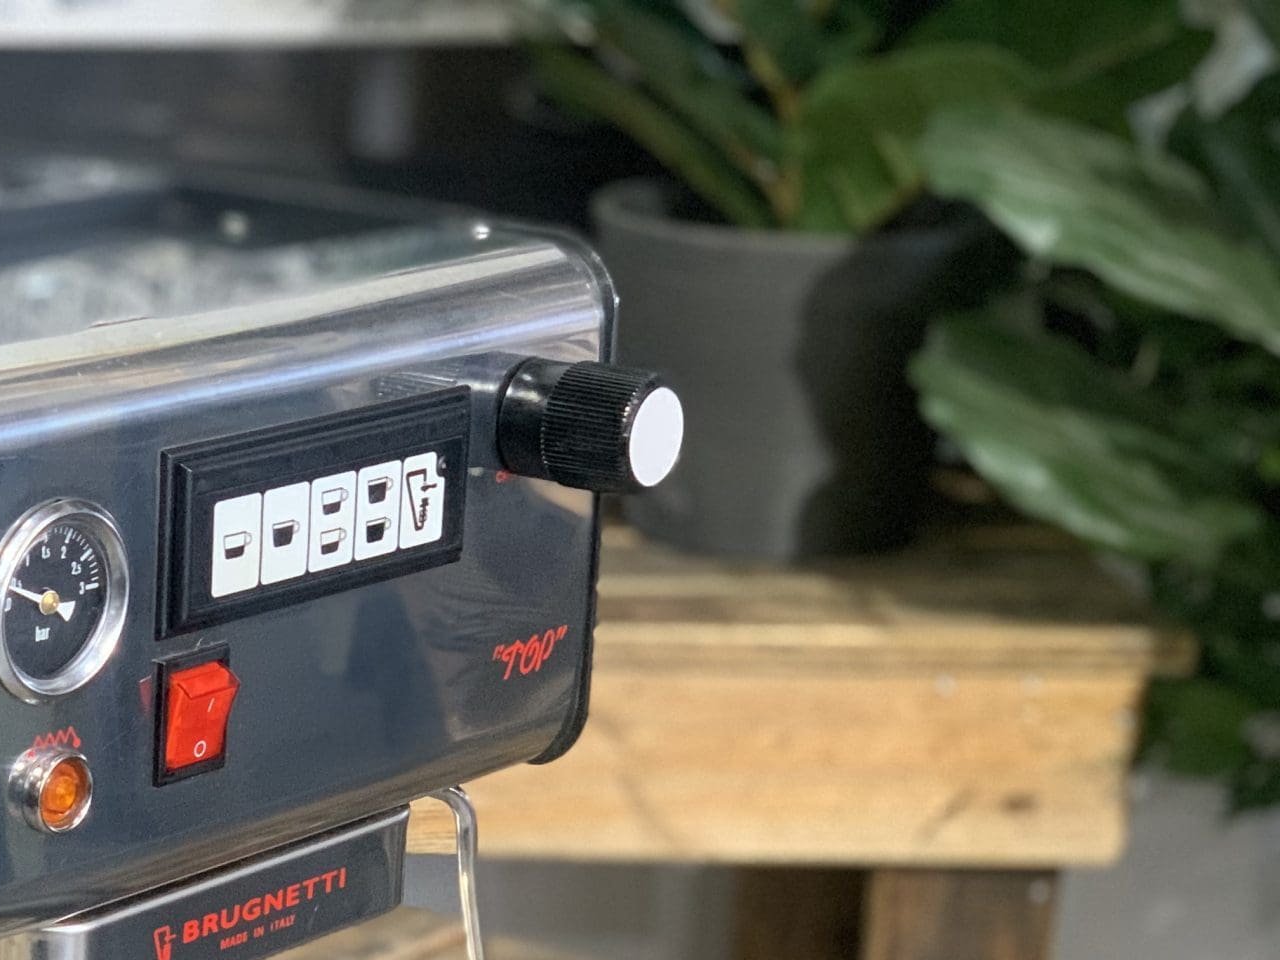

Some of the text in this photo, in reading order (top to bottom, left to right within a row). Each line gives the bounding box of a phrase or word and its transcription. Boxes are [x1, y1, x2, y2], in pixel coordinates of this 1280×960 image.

[60, 545, 67, 560] 2
[78, 581, 85, 595] 3
[35, 625, 51, 642] bar
[182, 866, 348, 945] BRUGNETTI
[220, 914, 297, 950] MADE IN ITALY
